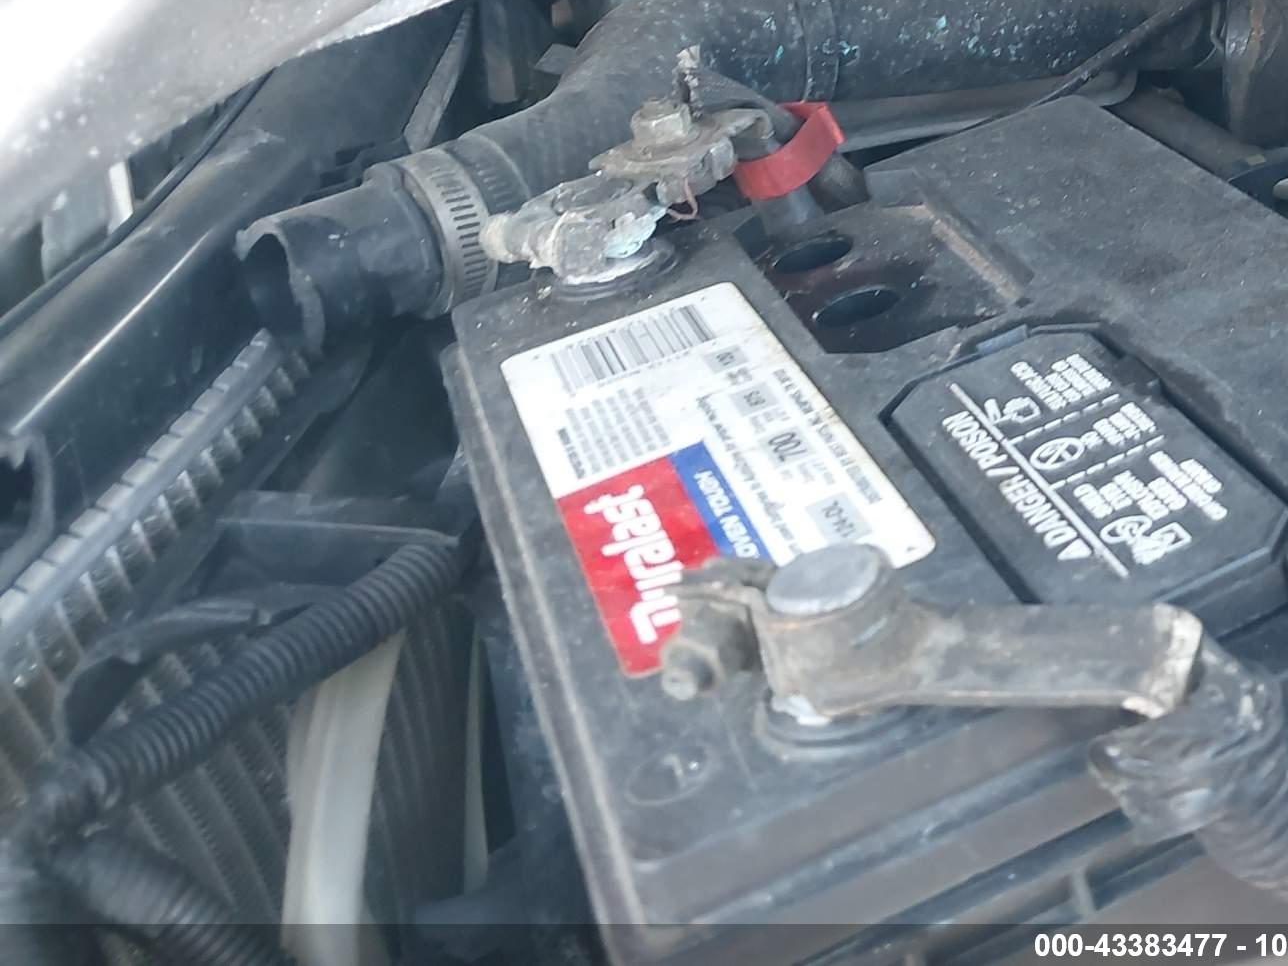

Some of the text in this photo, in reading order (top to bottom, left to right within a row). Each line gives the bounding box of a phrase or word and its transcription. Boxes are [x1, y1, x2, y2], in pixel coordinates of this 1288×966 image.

[769, 430, 806, 463] 700
[942, 411, 1008, 470] POISON
[693, 470, 761, 560] OVEN TOUGH
[999, 473, 1079, 548] DANGER
